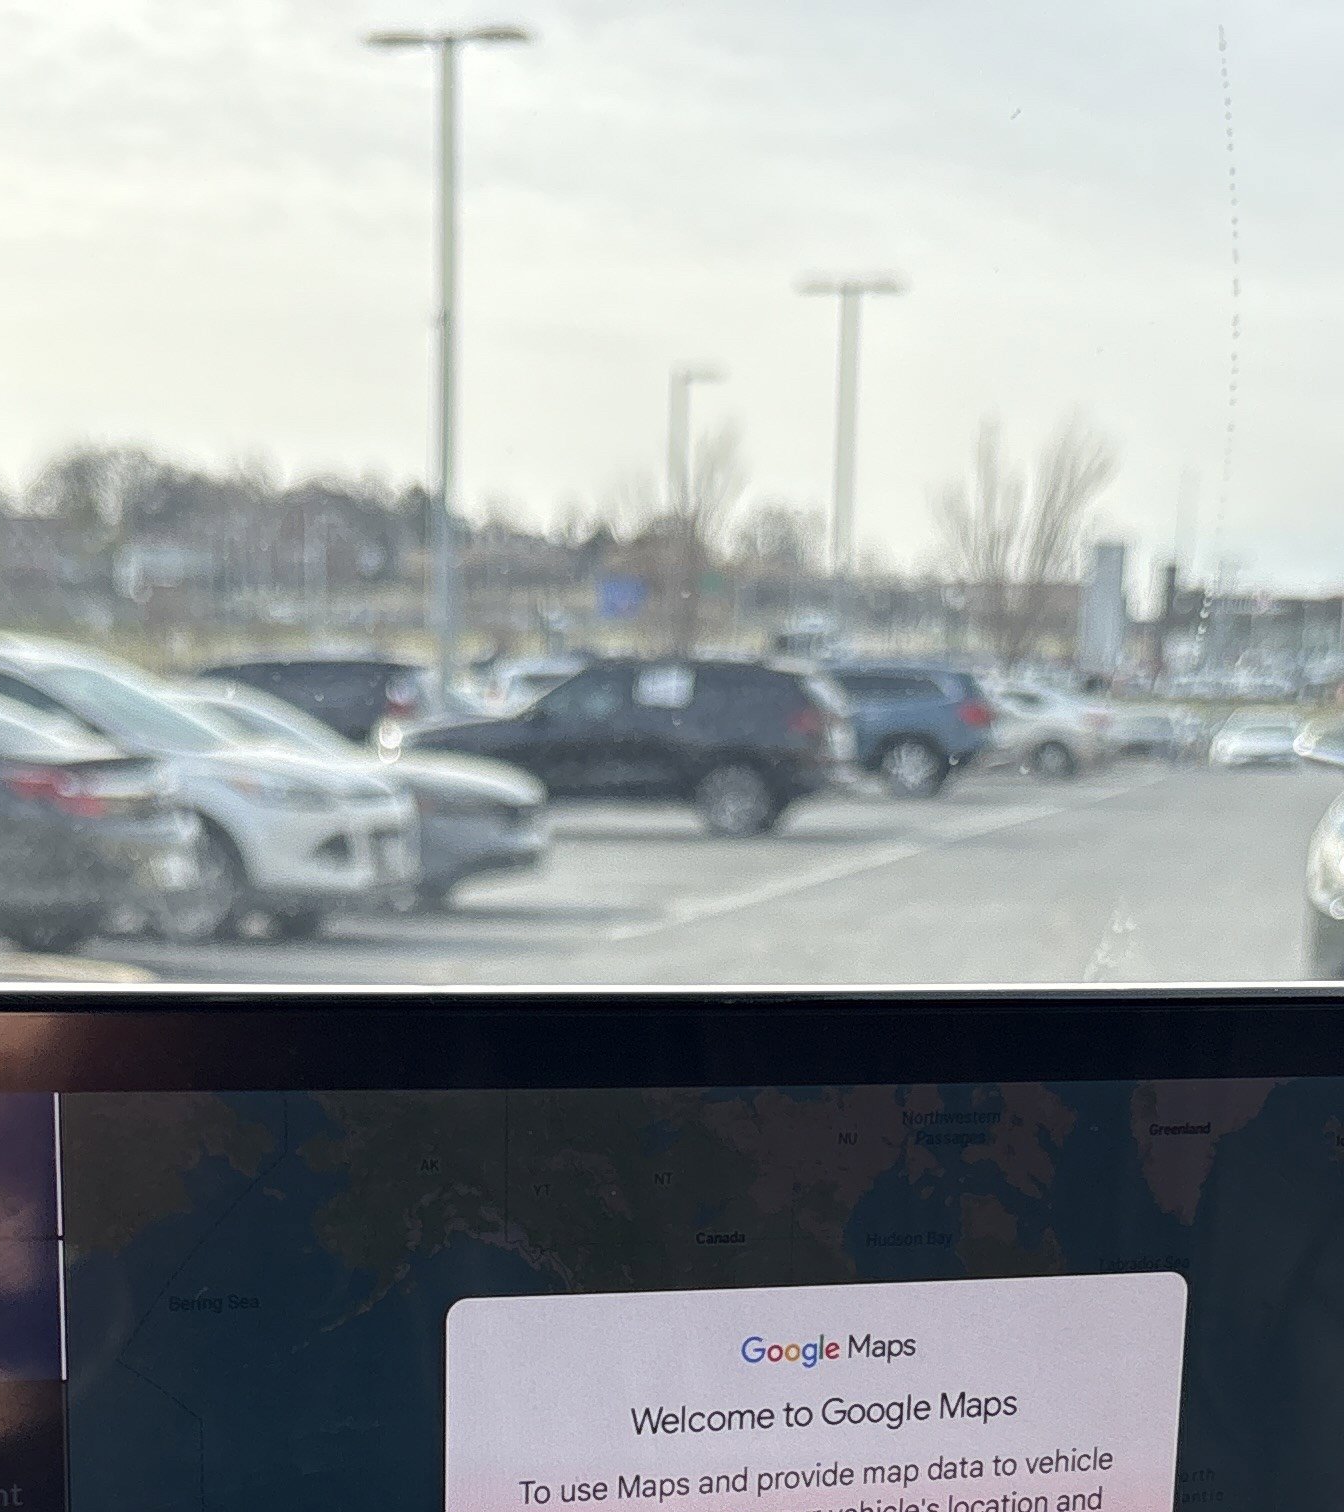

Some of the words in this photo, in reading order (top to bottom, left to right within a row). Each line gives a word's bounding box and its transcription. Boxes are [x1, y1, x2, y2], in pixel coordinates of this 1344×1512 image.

[1149, 1122, 1211, 1136] Greenland
[421, 1158, 439, 1173] AK
[654, 1172, 673, 1186] NT
[696, 1231, 746, 1246] Canada
[866, 1232, 923, 1248] Hudson
[928, 1231, 953, 1249] Bay
[169, 1296, 222, 1313] Bering
[228, 1294, 260, 1309] Sea
[741, 1335, 840, 1368] Google
[847, 1333, 916, 1361] Maps
[631, 1405, 774, 1436] Welcome
[785, 1404, 814, 1429] to
[822, 1395, 932, 1430] Google
[940, 1391, 1018, 1423] Maps
[520, 1480, 551, 1505] To
[561, 1479, 608, 1503] use
[617, 1472, 691, 1505] Maps
[699, 1467, 749, 1496] and
[757, 1462, 855, 1499] provide
[863, 1459, 919, 1490] map
[928, 1455, 984, 1483] data
[991, 1454, 1017, 1478] to
[1025, 1447, 1114, 1475] vehicle
[1180, 1468, 1216, 1483] orth
